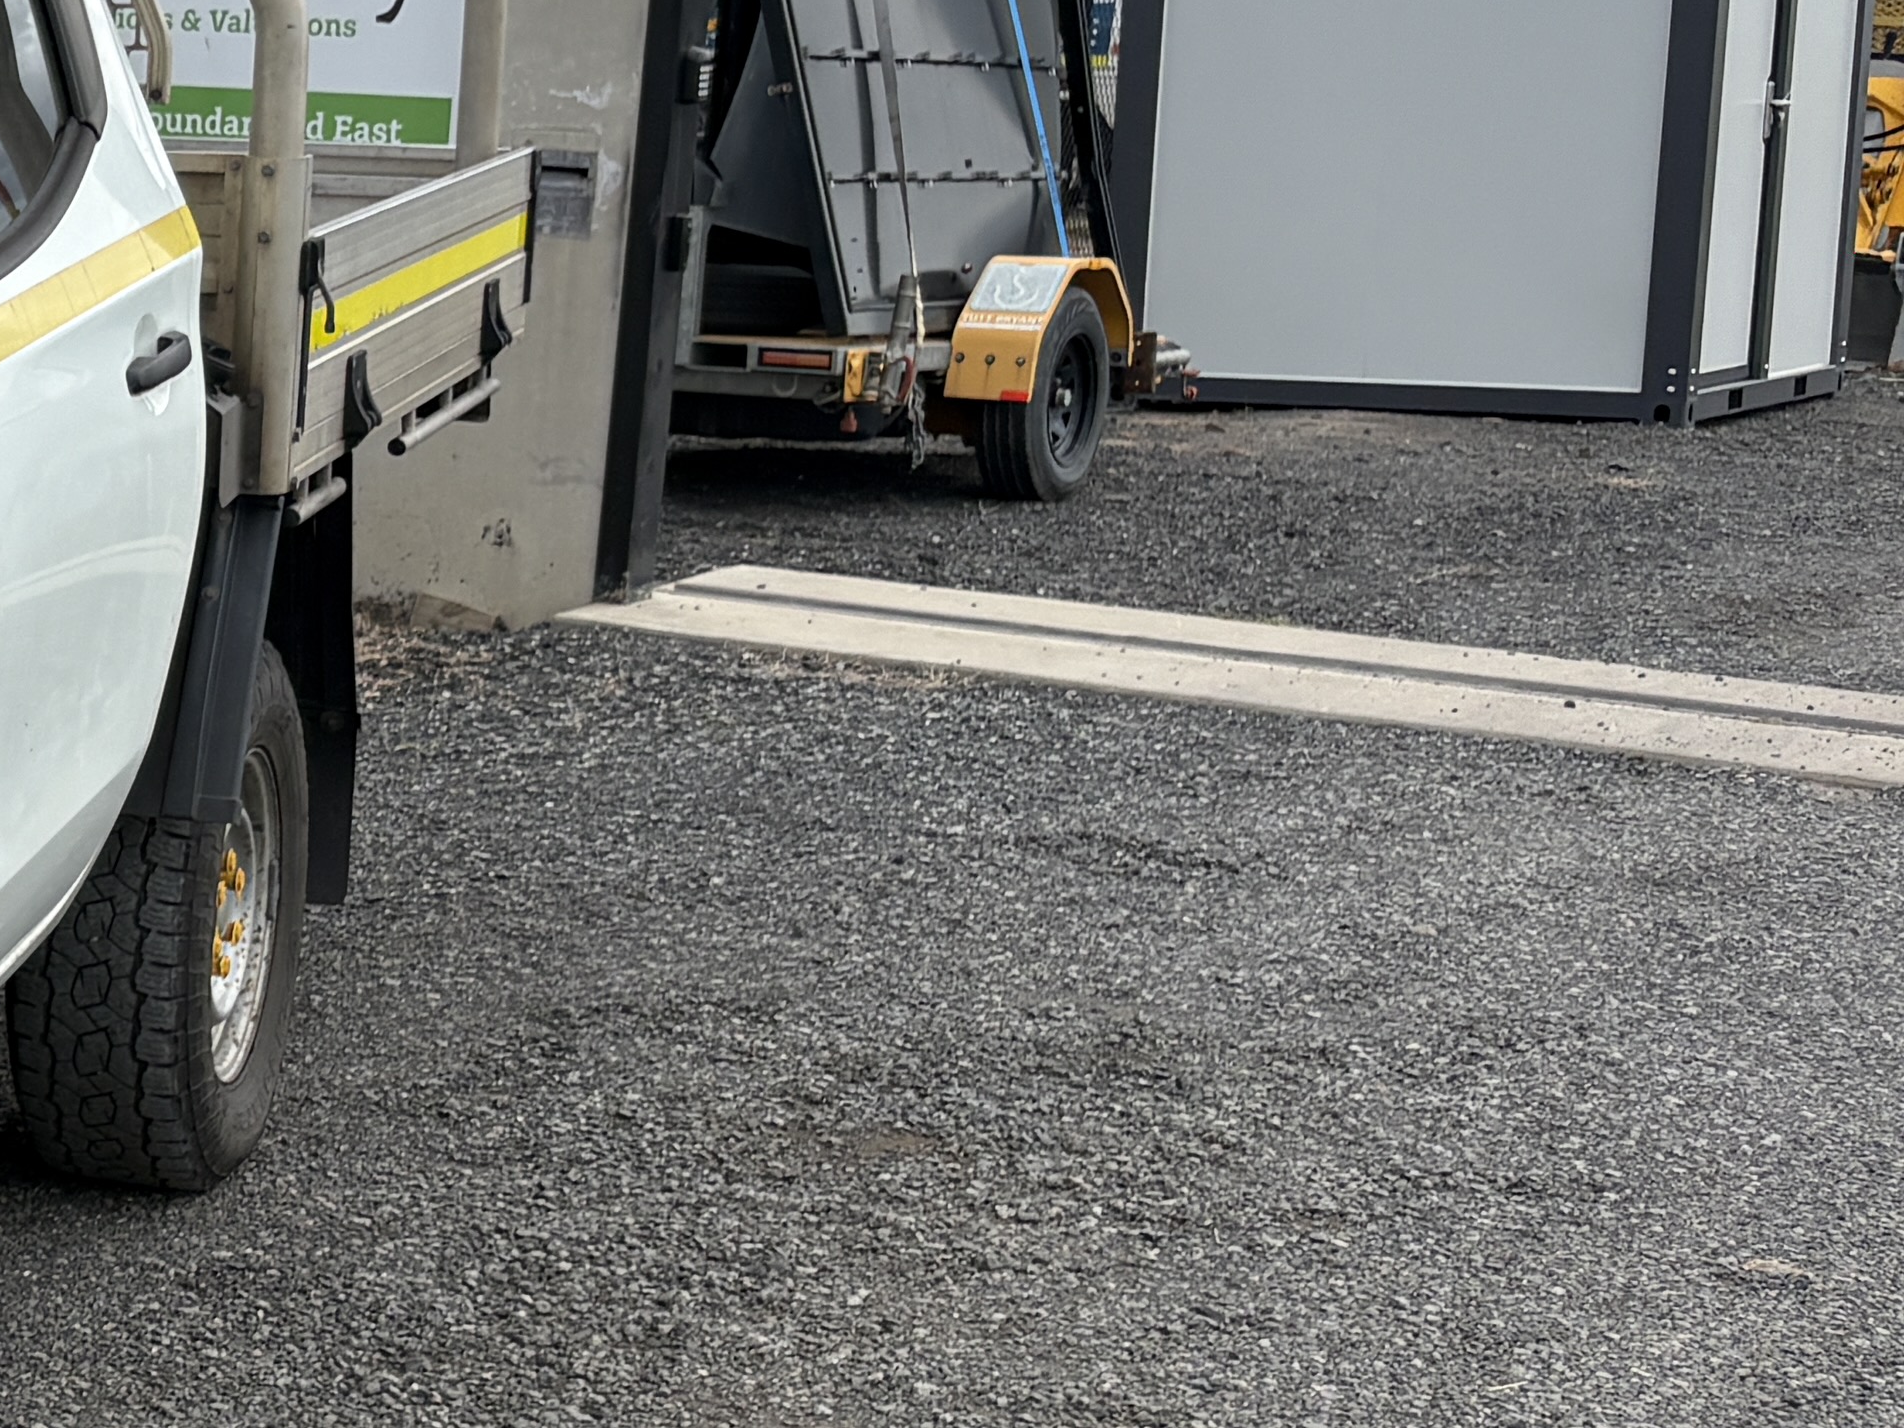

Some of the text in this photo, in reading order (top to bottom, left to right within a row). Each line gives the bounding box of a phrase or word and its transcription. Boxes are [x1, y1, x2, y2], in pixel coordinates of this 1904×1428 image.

[181, 9, 200, 32] &
[209, 10, 357, 38] Valons
[333, 115, 403, 145] East
